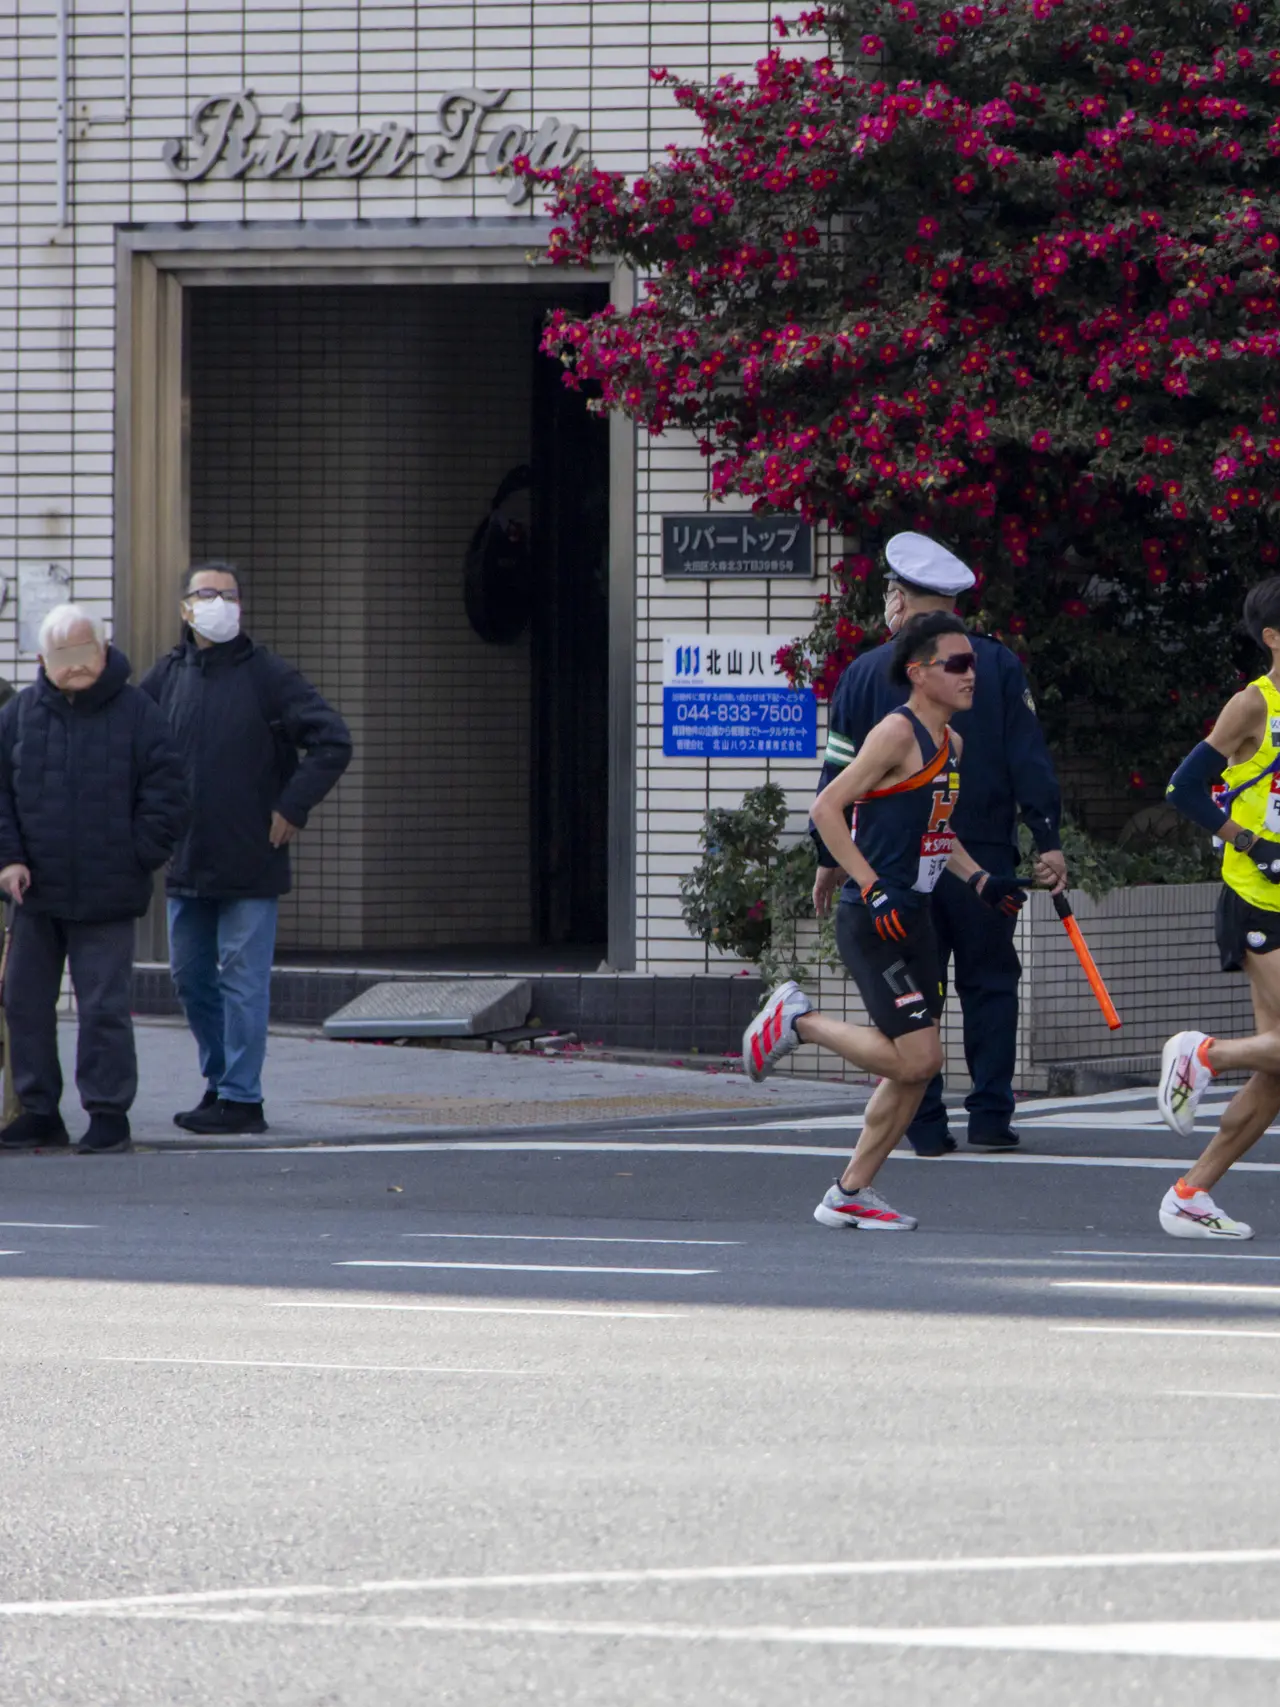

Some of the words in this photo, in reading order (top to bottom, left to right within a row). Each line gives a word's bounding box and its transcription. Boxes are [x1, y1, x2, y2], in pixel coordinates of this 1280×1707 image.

[162, 88, 416, 181] River
[424, 86, 585, 206] Top
[673, 524, 800, 553] リバートップ
[677, 704, 803, 722] 044-833-7500
